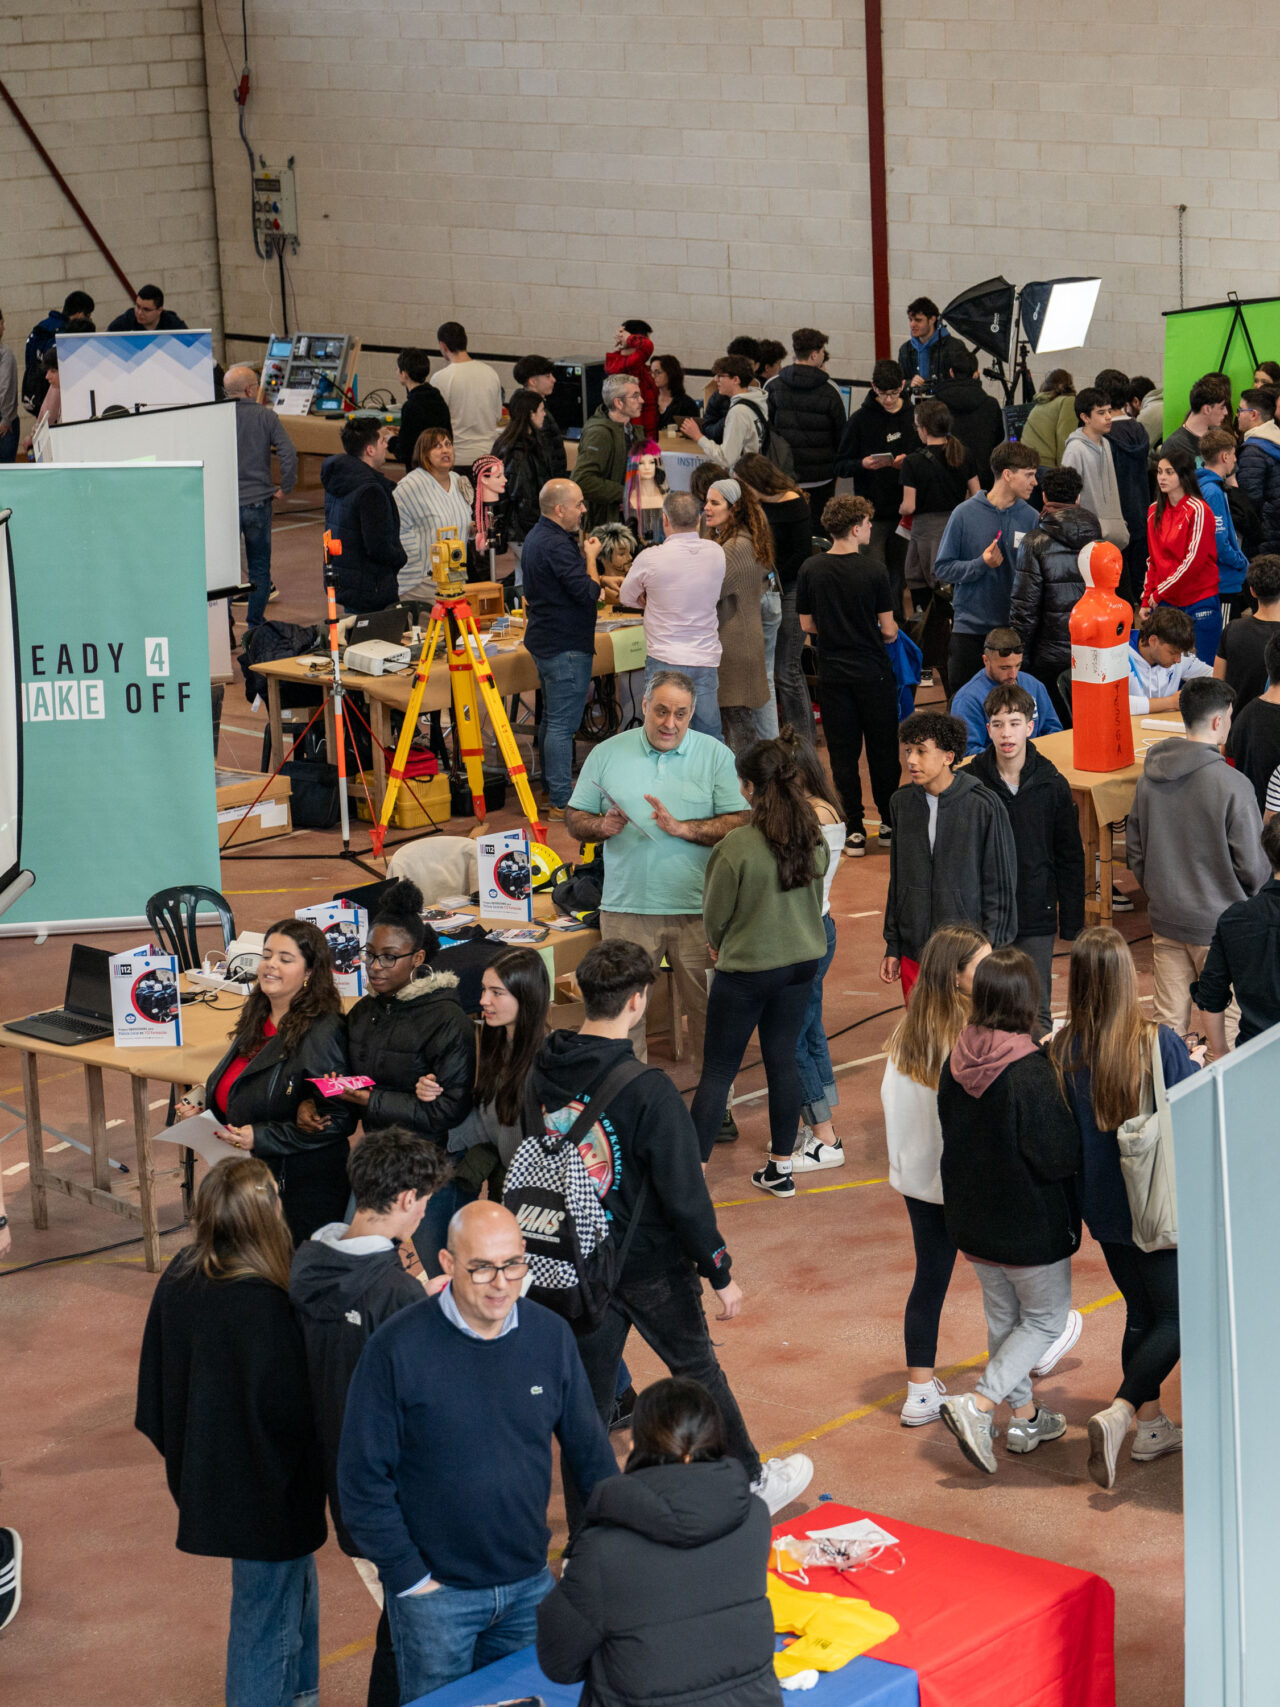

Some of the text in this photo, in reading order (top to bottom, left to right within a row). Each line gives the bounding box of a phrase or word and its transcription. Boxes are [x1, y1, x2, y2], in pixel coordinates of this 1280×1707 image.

[31, 642, 165, 676] EADY 4
[32, 682, 190, 718] AKE OFF
[120, 965, 131, 974] 112
[602, 1120, 615, 1134] OF
[516, 1203, 566, 1236] VANS
